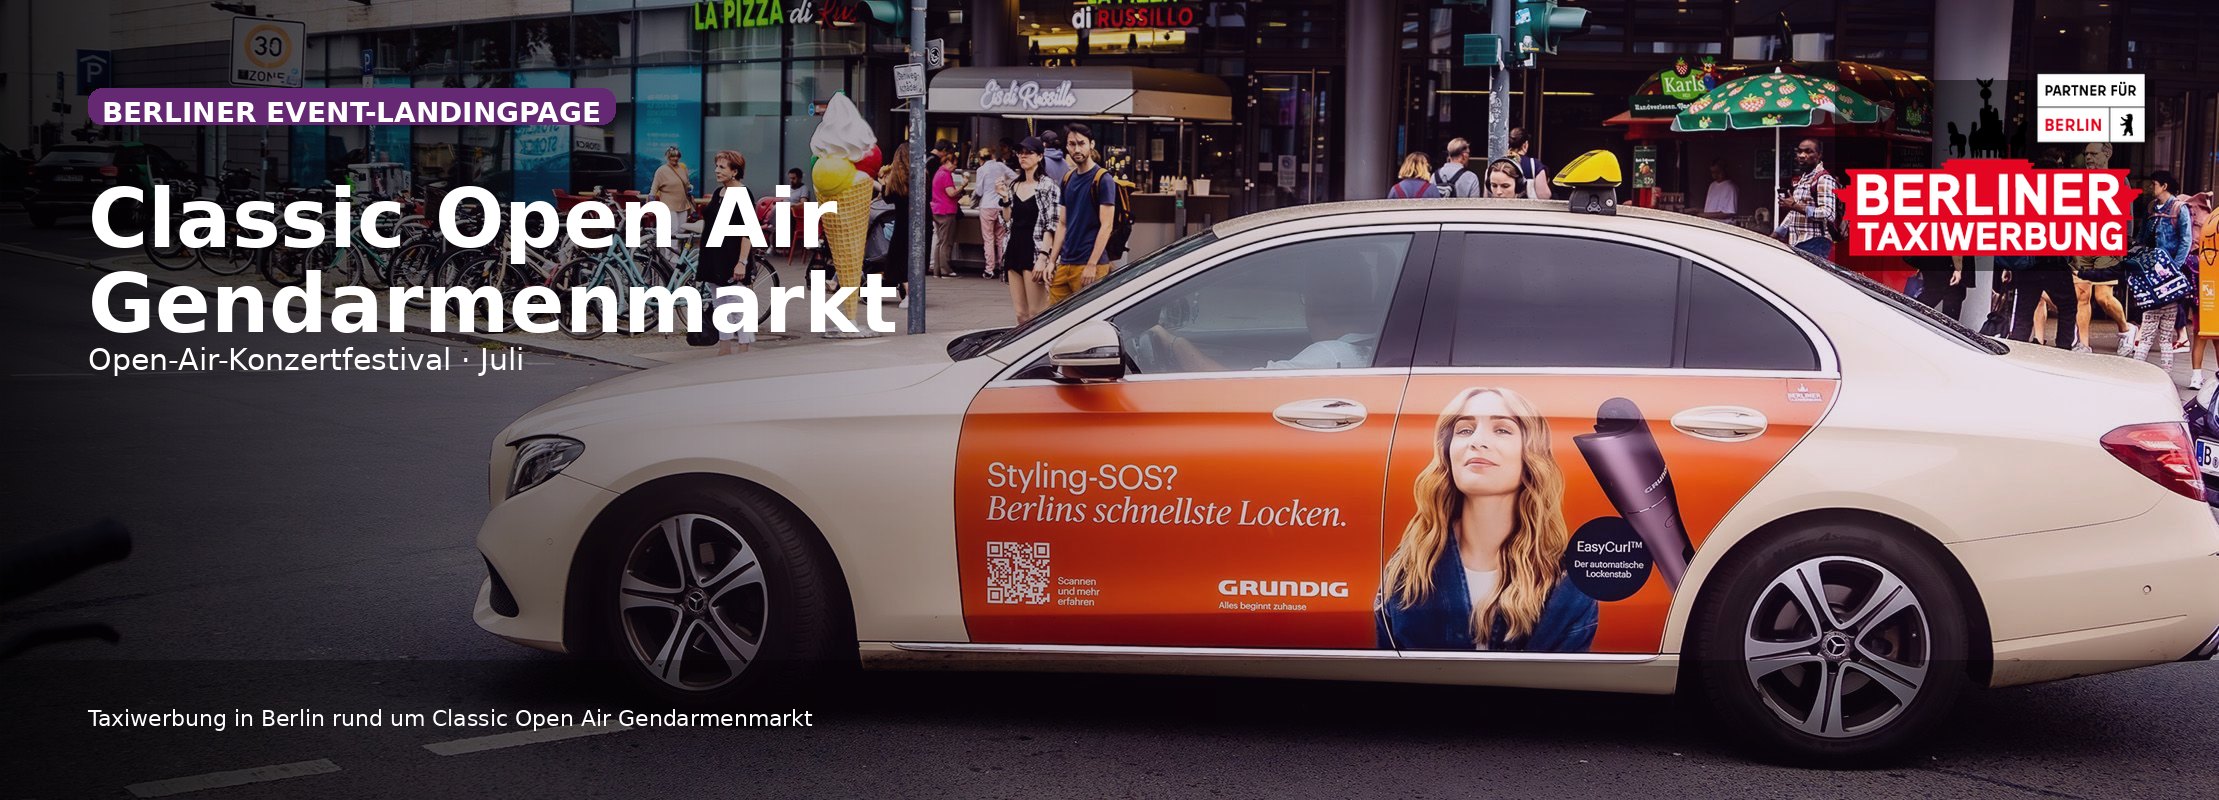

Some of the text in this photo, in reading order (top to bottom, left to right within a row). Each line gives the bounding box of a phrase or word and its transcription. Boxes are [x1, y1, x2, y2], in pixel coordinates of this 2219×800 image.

[695, 1, 718, 30] LA
[723, 0, 784, 28] PIZZA
[790, 0, 813, 24] di
[1072, 6, 1193, 29] di RUSSILLO
[254, 36, 282, 57] 30
[1664, 75, 1706, 92] Karls
[980, 79, 1077, 110] Eis di Russillo
[2204, 445, 2212, 465] B
[987, 461, 1178, 495] Styling-SOS?
[986, 495, 1347, 527] Berlins schnellste Locken.
[1574, 560, 1645, 569] Der automatische
[1057, 576, 1096, 586] Scannen
[1586, 570, 1632, 578] Lockenstab
[1057, 587, 1100, 596] und mehr
[1218, 580, 1349, 597] GRUNDIG
[1057, 597, 1095, 606] erfahren
[1218, 601, 1307, 611] Alles beginnt zuhause
